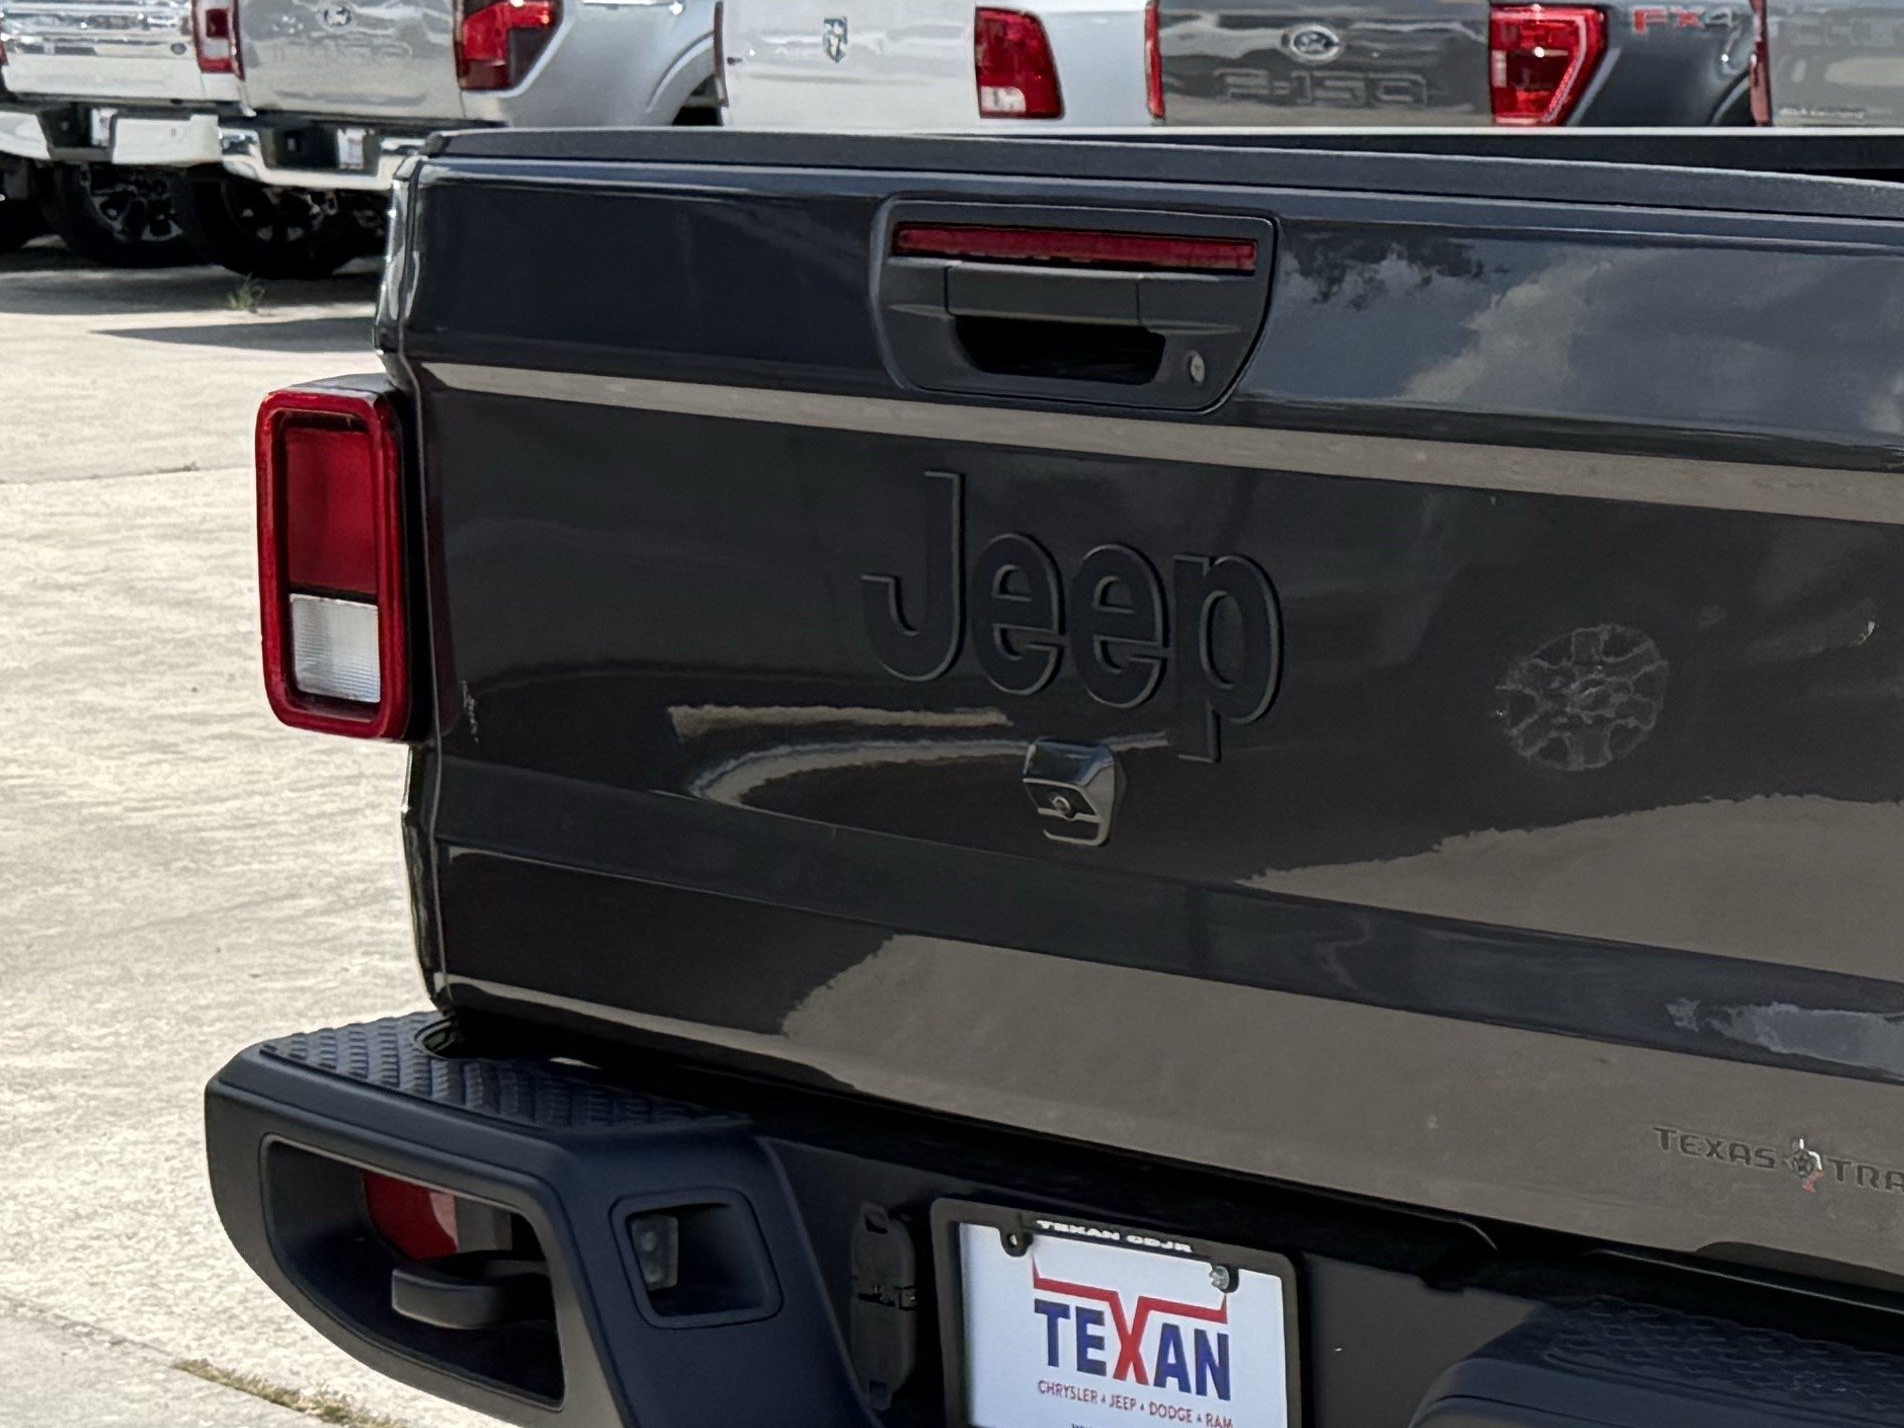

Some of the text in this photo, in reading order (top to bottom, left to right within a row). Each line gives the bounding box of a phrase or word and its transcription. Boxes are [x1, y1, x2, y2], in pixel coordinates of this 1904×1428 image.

[1632, 5, 1733, 35] FX4
[861, 470, 1283, 763] Jeep
[1653, 1126, 1776, 1170] TEXAS
[1033, 1259, 1231, 1401] TEXAN
[1037, 1379, 1098, 1406] CHRYSLER
[1109, 1393, 1137, 1413] JEEP
[1148, 1401, 1193, 1424] DODGE
